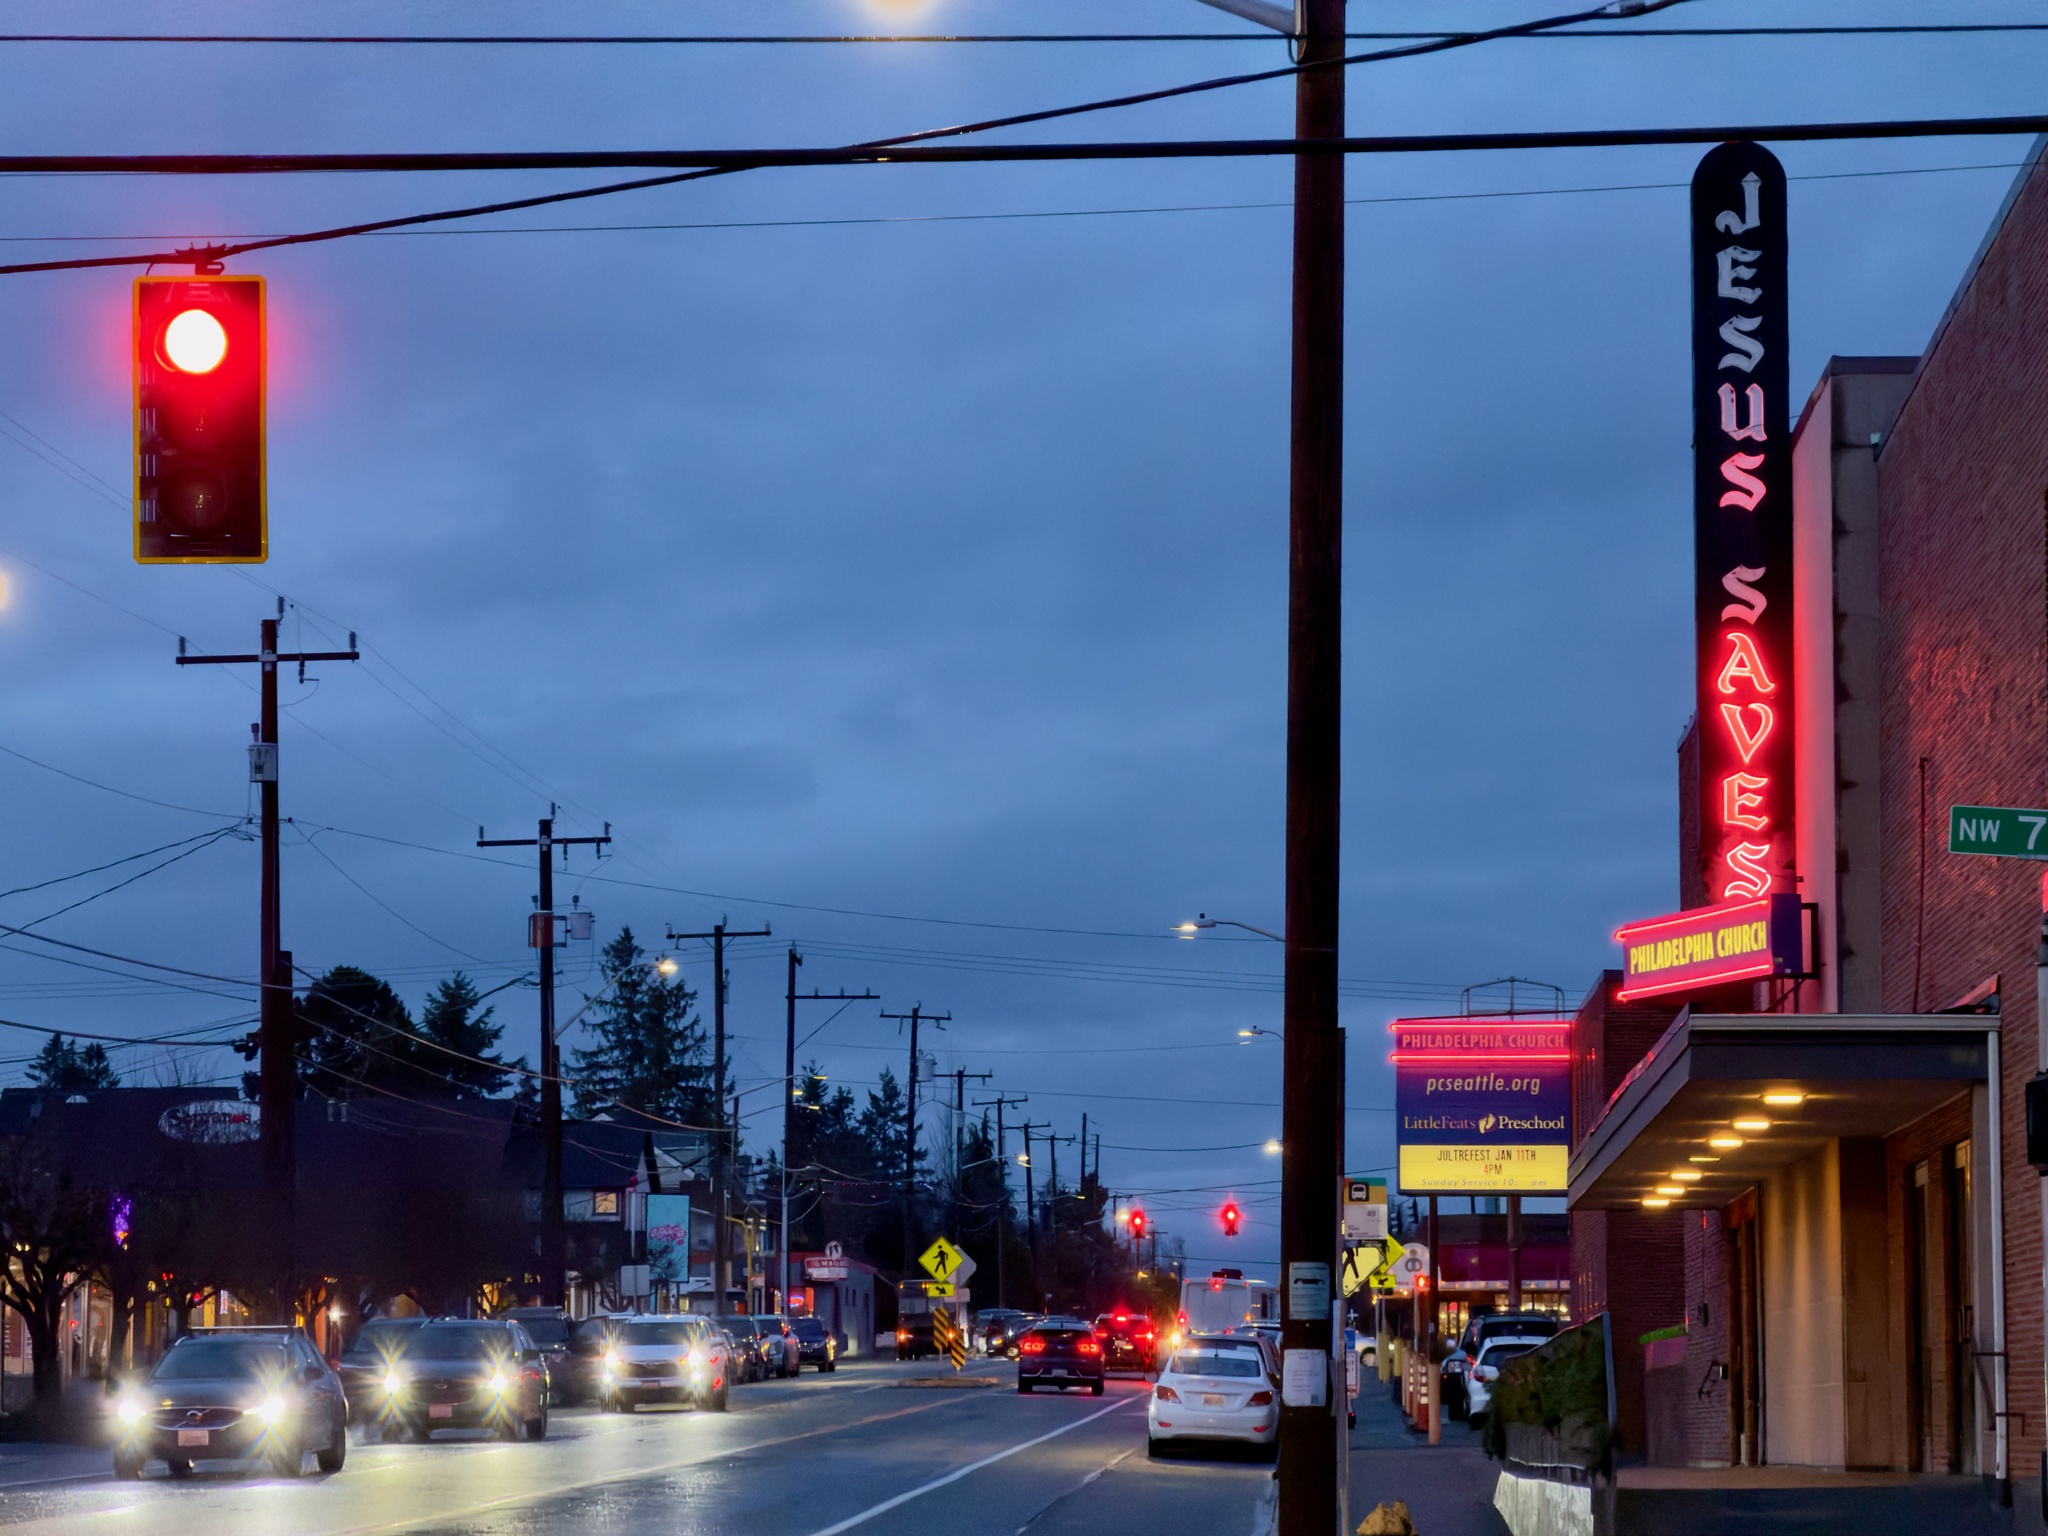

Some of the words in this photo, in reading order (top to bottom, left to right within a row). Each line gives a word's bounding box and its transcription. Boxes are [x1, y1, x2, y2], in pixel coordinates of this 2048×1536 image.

[1715, 171, 1768, 512] JESUS
[1717, 564, 1776, 899] SAVES
[1960, 818, 2000, 843] NW
[1630, 931, 1715, 975] PHILADELPHIA
[1716, 920, 1767, 958] CHURCH
[1402, 1034, 1503, 1048] PHILADELPHIA
[1508, 1034, 1565, 1048] CHURCH
[1426, 1072, 1540, 1096] pcseattle.org
[1498, 1115, 1565, 1130] Preschool
[1437, 1149, 1491, 1162] JULTREFEST
[1495, 1149, 1512, 1162] JAN
[1516, 1149, 1536, 1162] 11TH
[1483, 1163, 1503, 1176] 4PM
[1421, 1178, 1459, 1188] Sunday
[1461, 1178, 1498, 1187] Service
